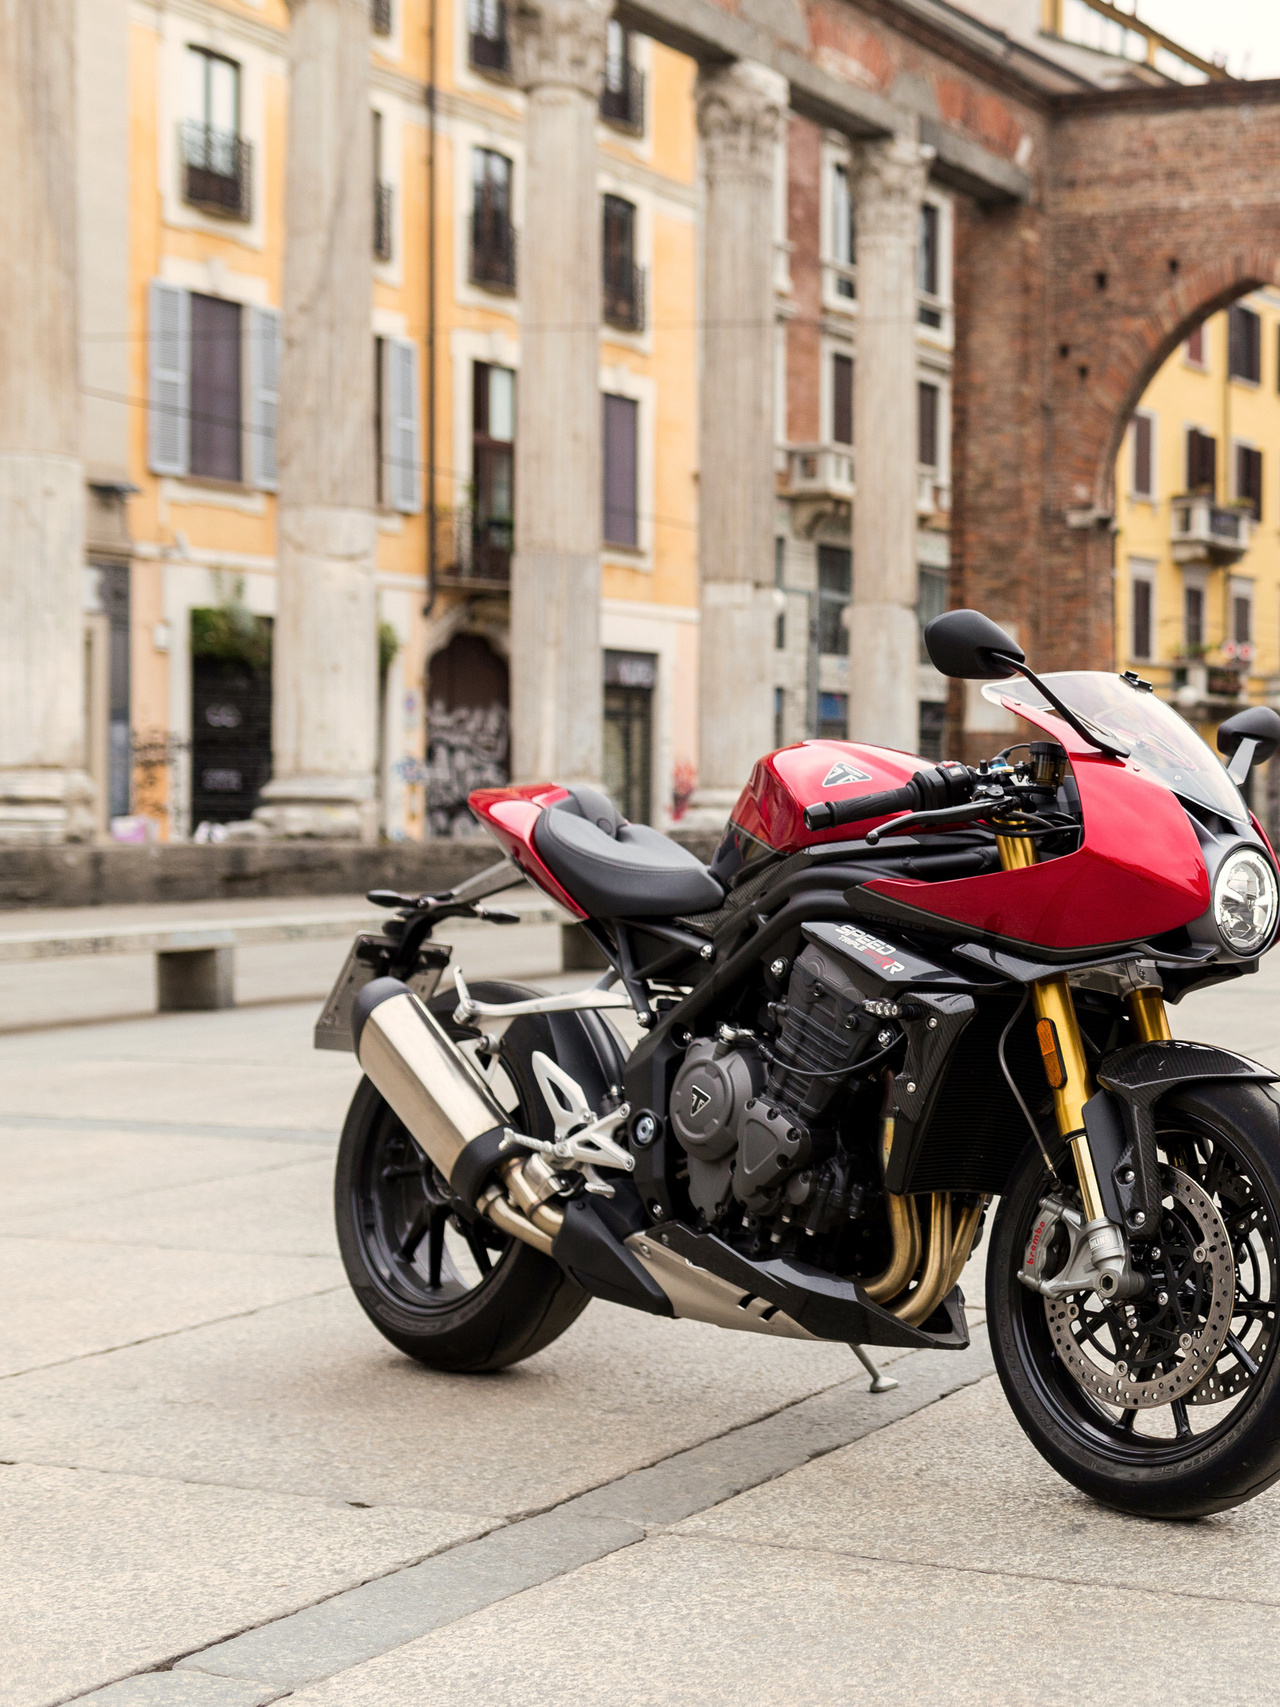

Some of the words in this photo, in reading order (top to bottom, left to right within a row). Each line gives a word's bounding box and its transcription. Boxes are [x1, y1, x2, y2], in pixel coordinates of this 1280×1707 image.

[835, 924, 897, 956] SPEED
[838, 935, 868, 952] TRIPLE
[1026, 1221, 1045, 1265] brembo
